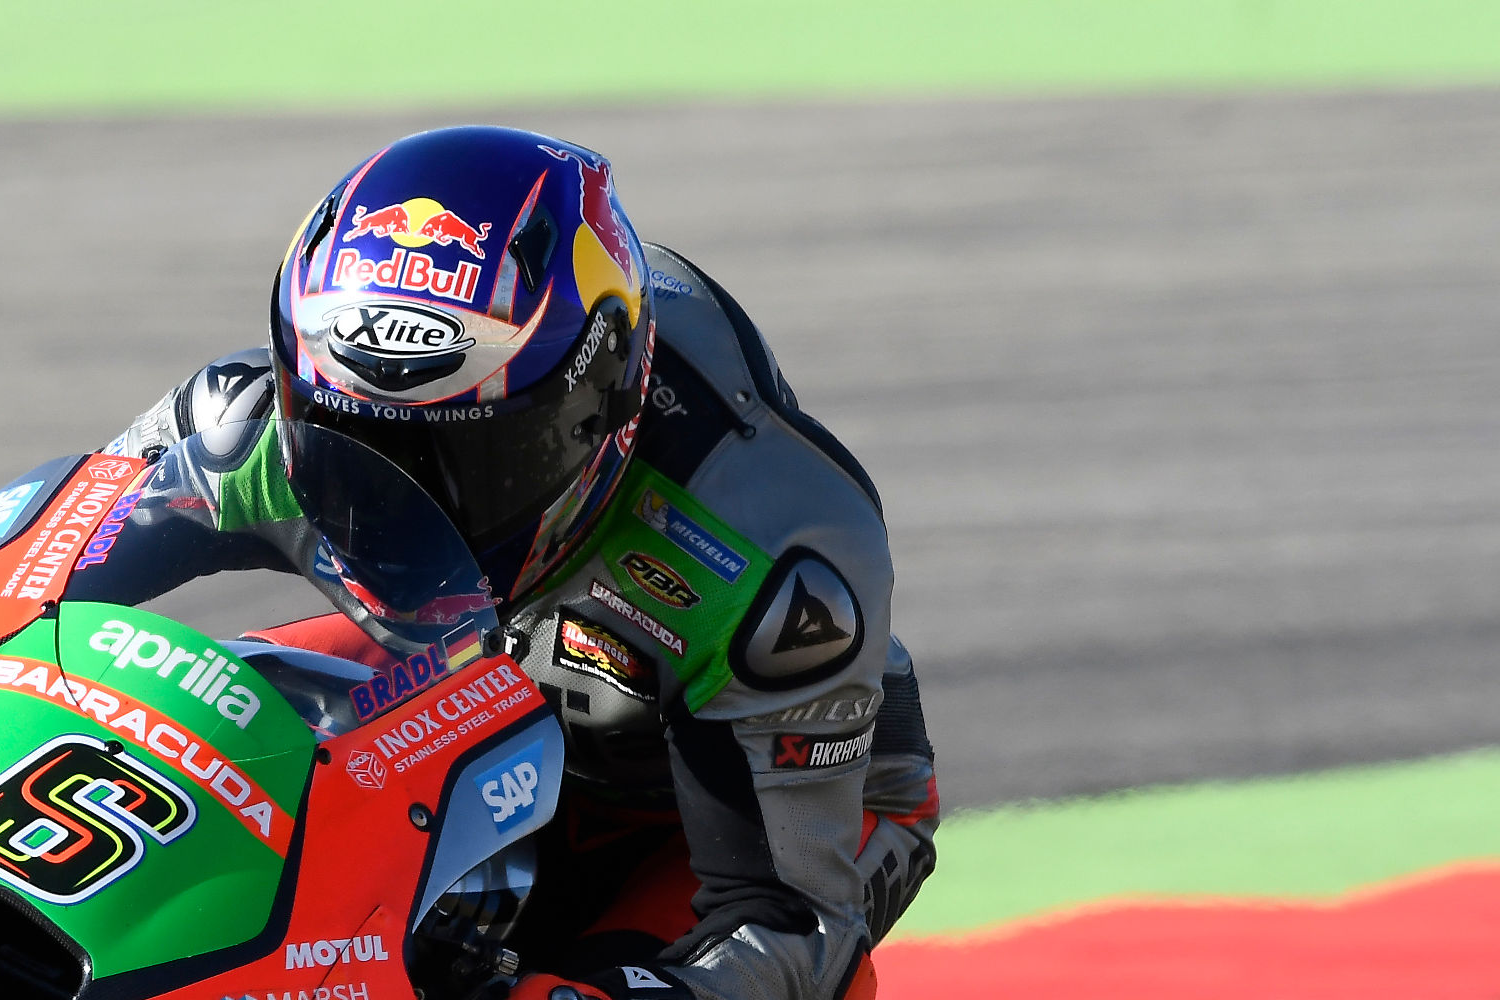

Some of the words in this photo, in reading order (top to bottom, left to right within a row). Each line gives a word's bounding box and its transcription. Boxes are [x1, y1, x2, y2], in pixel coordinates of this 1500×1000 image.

[333, 248, 405, 287] Red
[403, 253, 480, 301] Bull
[650, 270, 693, 296] GGIO
[344, 308, 446, 347] X-lite
[564, 311, 609, 393] X-802RR
[313, 391, 360, 414] GIVES
[371, 405, 411, 421] YOU
[424, 405, 494, 422] WINGS
[45, 481, 89, 528] STAINLESS
[65, 482, 119, 527] INOX
[75, 488, 145, 571] BRADL
[17, 529, 82, 600] CENTER
[23, 529, 51, 560] STEEL
[670, 520, 741, 574] MICHELIN
[0, 561, 31, 597] TRADE
[592, 581, 684, 656] BARRACUDA
[565, 626, 629, 667] ILMBERGER
[88, 619, 261, 730] aprilia
[350, 643, 450, 721] BRADL
[373, 709, 445, 760] INOX
[437, 663, 522, 721] CENTER
[393, 730, 458, 774] STAINLESS
[457, 710, 495, 736] STEEL
[492, 686, 533, 714] TRADE
[481, 761, 538, 823] SAP
[285, 934, 389, 970] MOTUL
